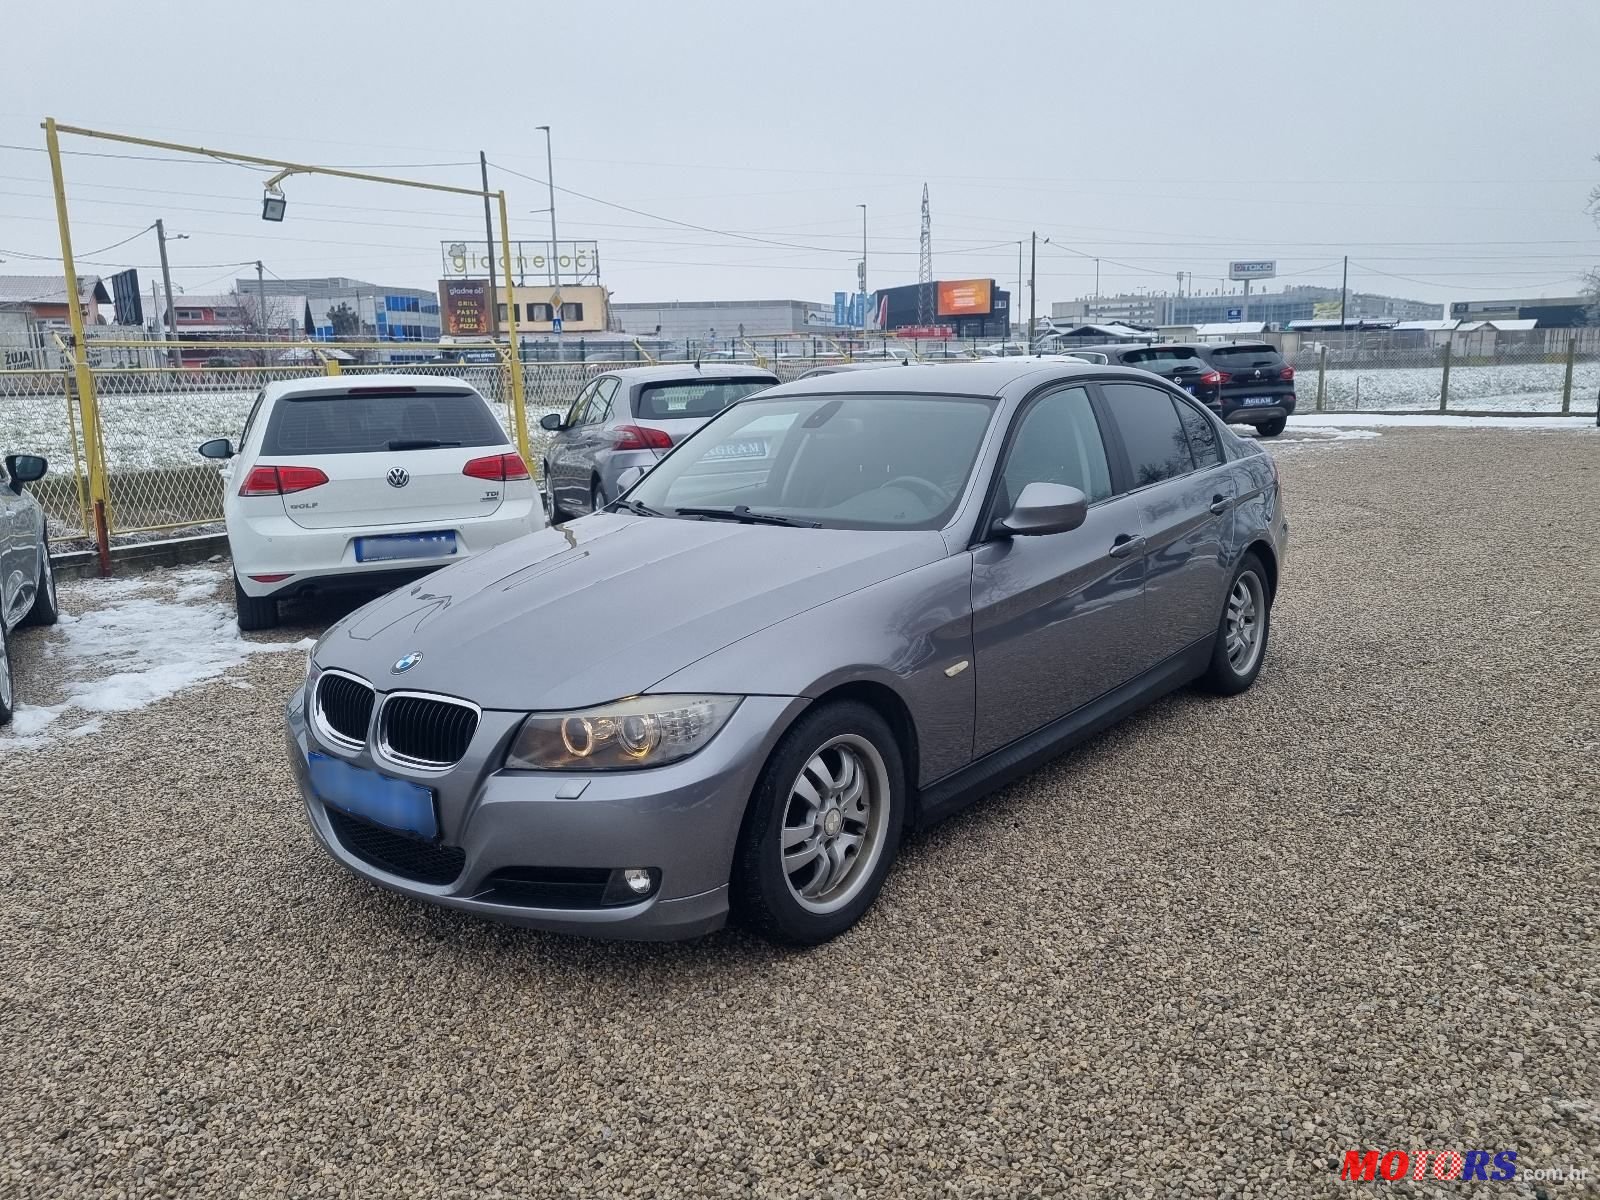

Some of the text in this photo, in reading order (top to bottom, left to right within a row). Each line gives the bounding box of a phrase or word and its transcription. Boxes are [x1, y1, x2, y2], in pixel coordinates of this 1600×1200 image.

[559, 250, 595, 268] oči
[450, 287, 473, 296] gladne
[5, 349, 31, 365] ŽUJA
